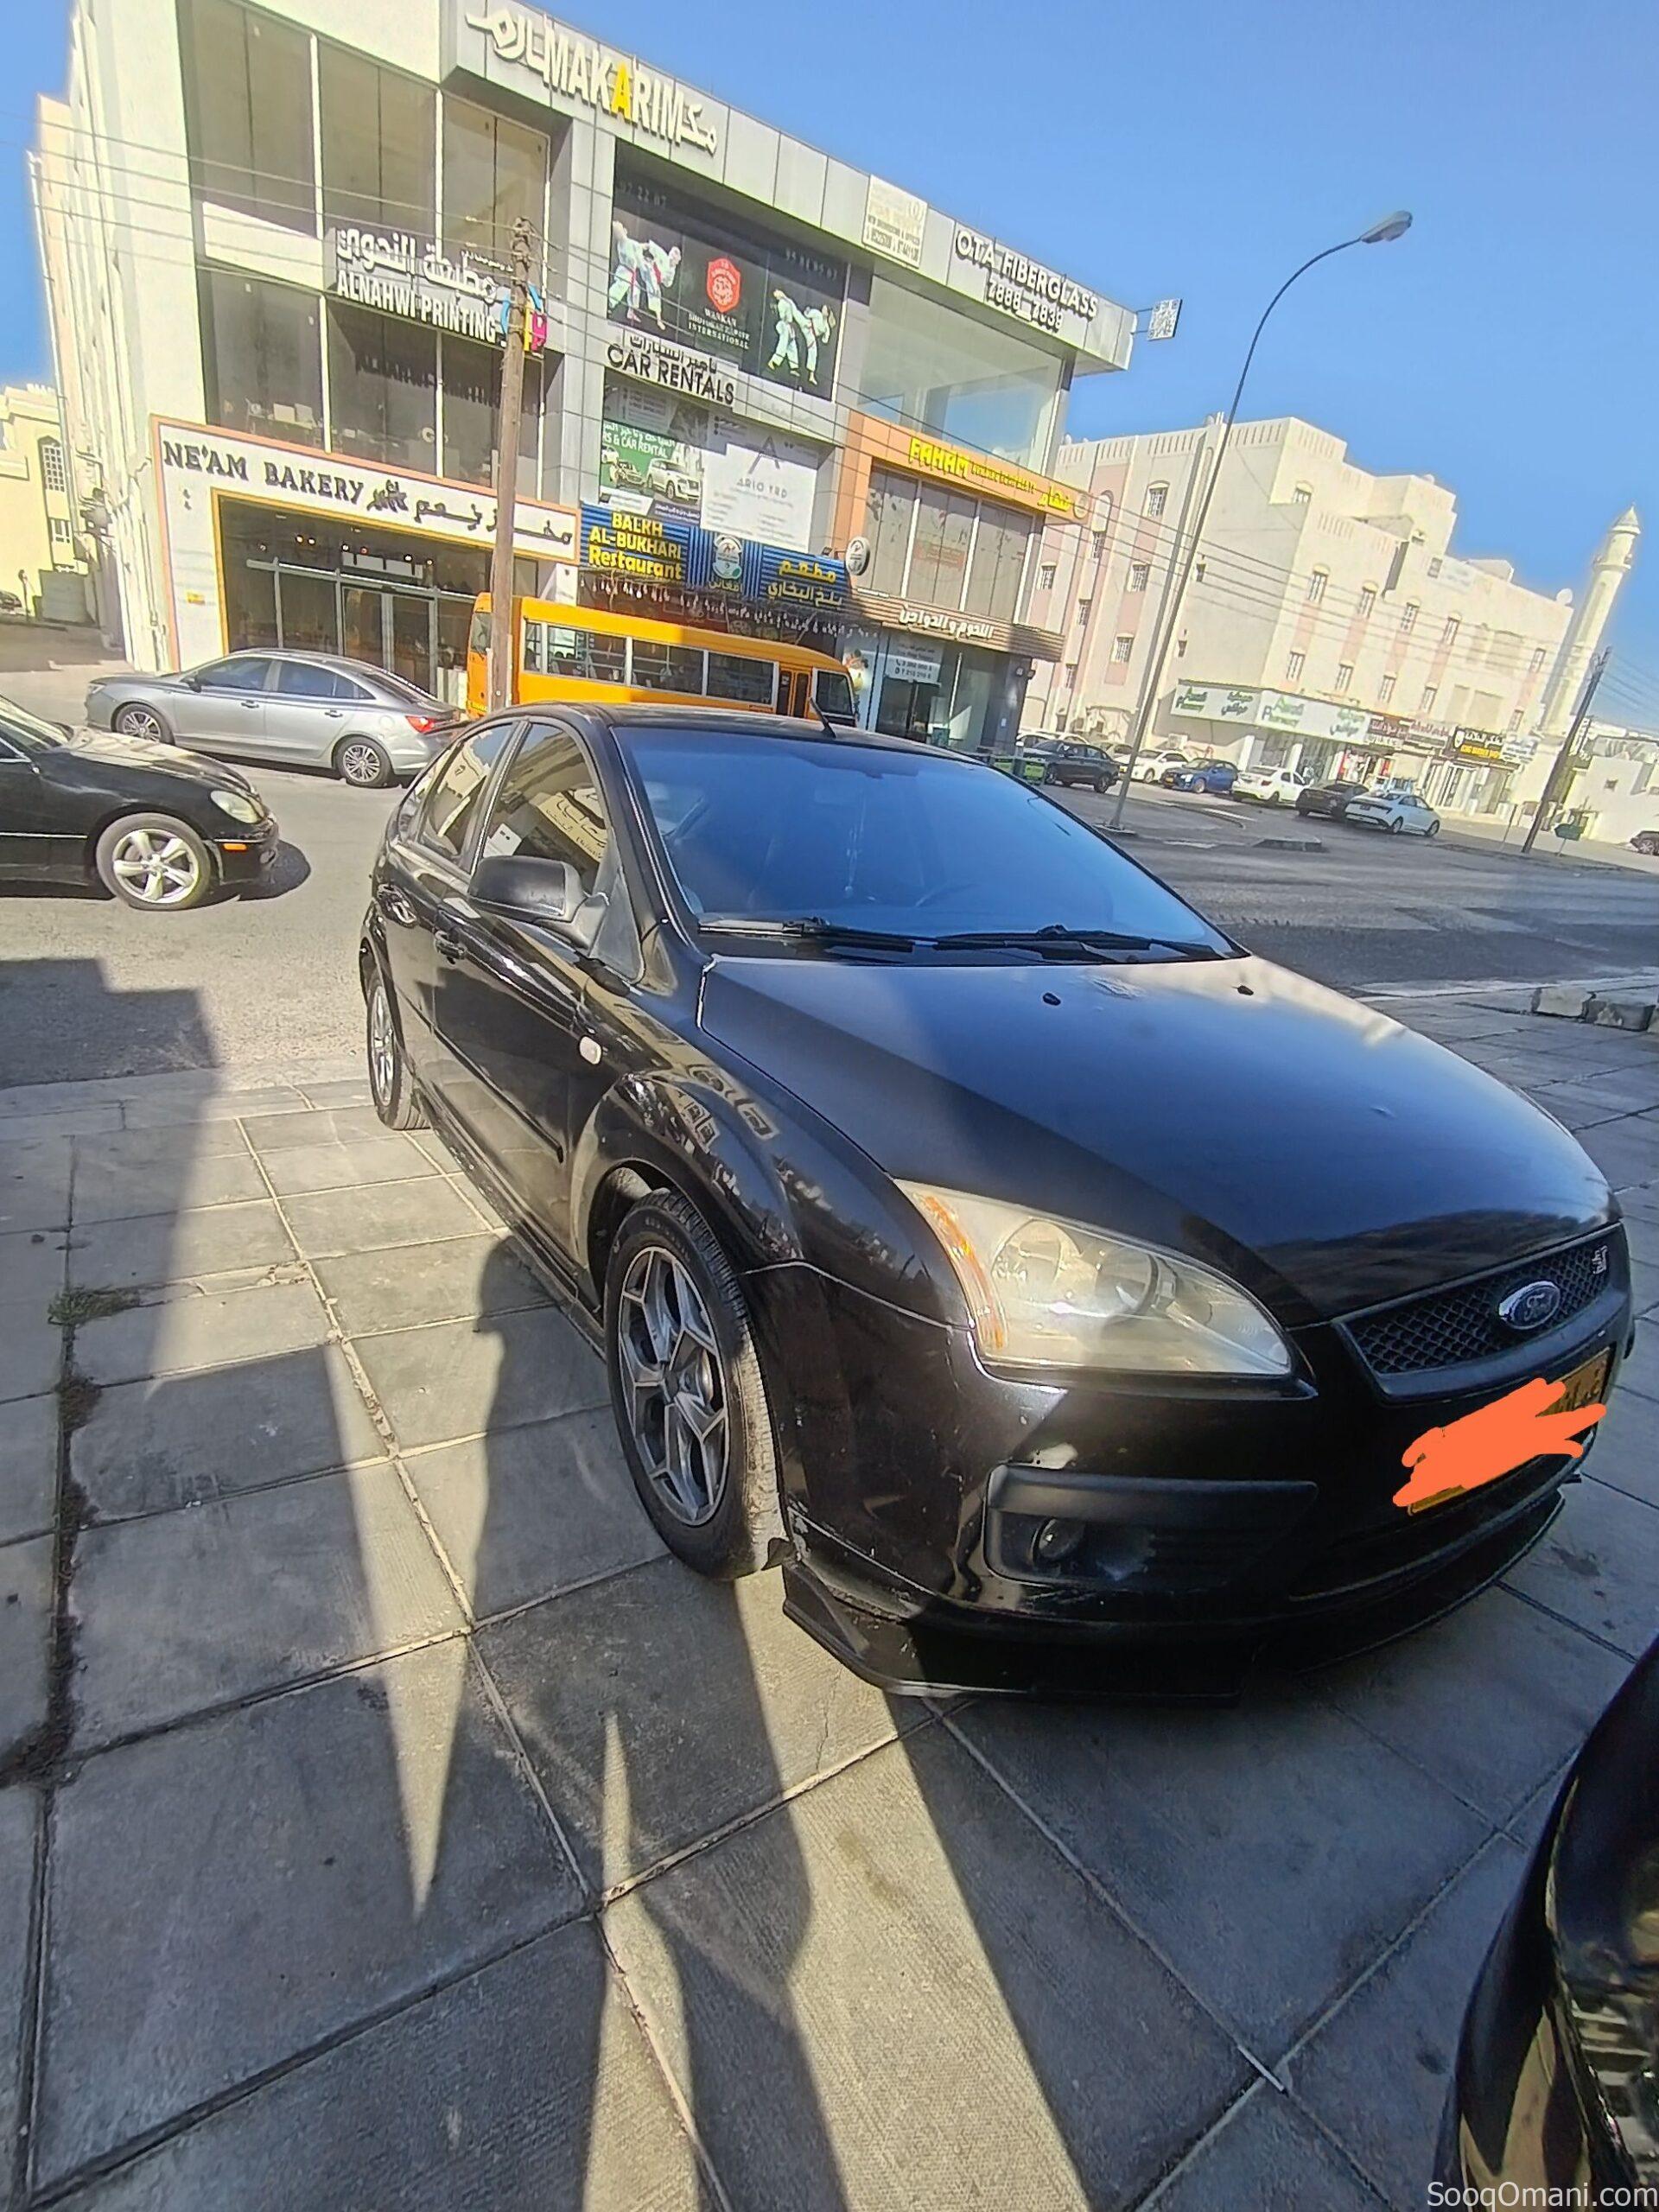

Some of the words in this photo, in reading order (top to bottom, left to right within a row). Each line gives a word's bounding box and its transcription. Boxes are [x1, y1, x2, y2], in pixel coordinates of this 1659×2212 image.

[337, 228, 416, 275] النحوي
[423, 244, 499, 303] مطبعة
[1001, 251, 1098, 319] FIBERGLASS
[337, 270, 416, 318] ALNAHWI
[421, 296, 497, 345] PRINTING
[630, 335, 684, 364] السيارات
[689, 322, 749, 350] INTERNATIONAL
[607, 344, 652, 378] CAR
[657, 360, 735, 406] RENTALS
[620, 435, 638, 453] CAR
[638, 440, 669, 459] RENTAL
[264, 462, 365, 505] BAKERY
[610, 512, 664, 537] BALKH
[588, 525, 682, 560] AL-BUKHARI
[588, 545, 683, 582] Restaurant
[779, 556, 838, 584] مطعم
[766, 579, 815, 601] البخاري
[814, 587, 844, 608] بلخ
[899, 607, 949, 631] الدواجن
[956, 620, 995, 641] اللحوم
